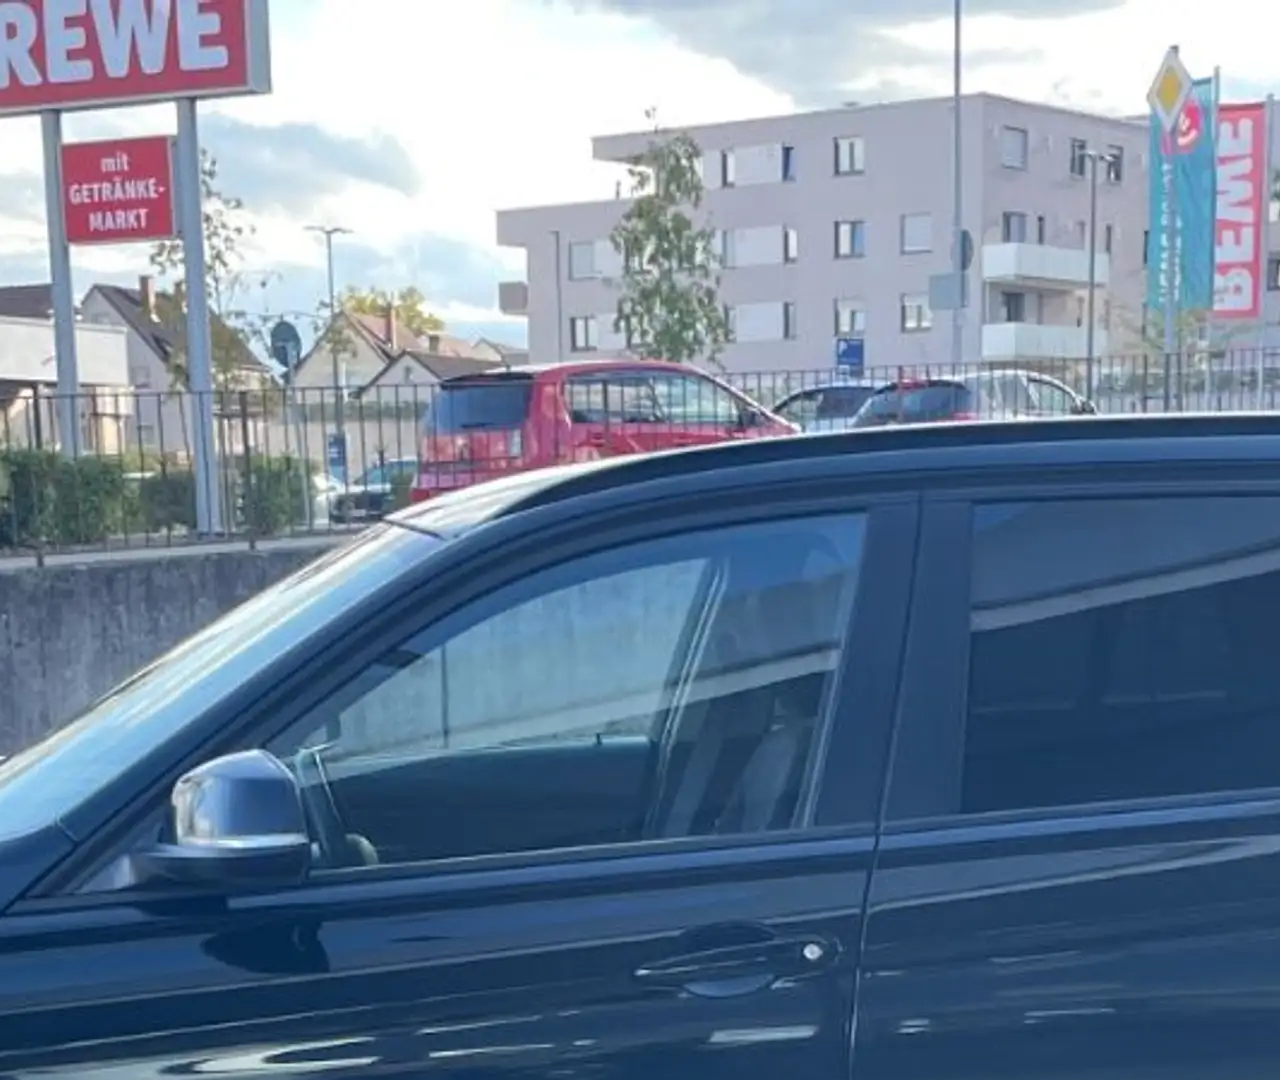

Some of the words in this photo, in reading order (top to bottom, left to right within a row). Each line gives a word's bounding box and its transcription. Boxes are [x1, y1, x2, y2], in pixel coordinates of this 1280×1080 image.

[101, 151, 129, 172] mit
[69, 176, 167, 205] GETRÄNKE-
[89, 208, 149, 232] MARKT
